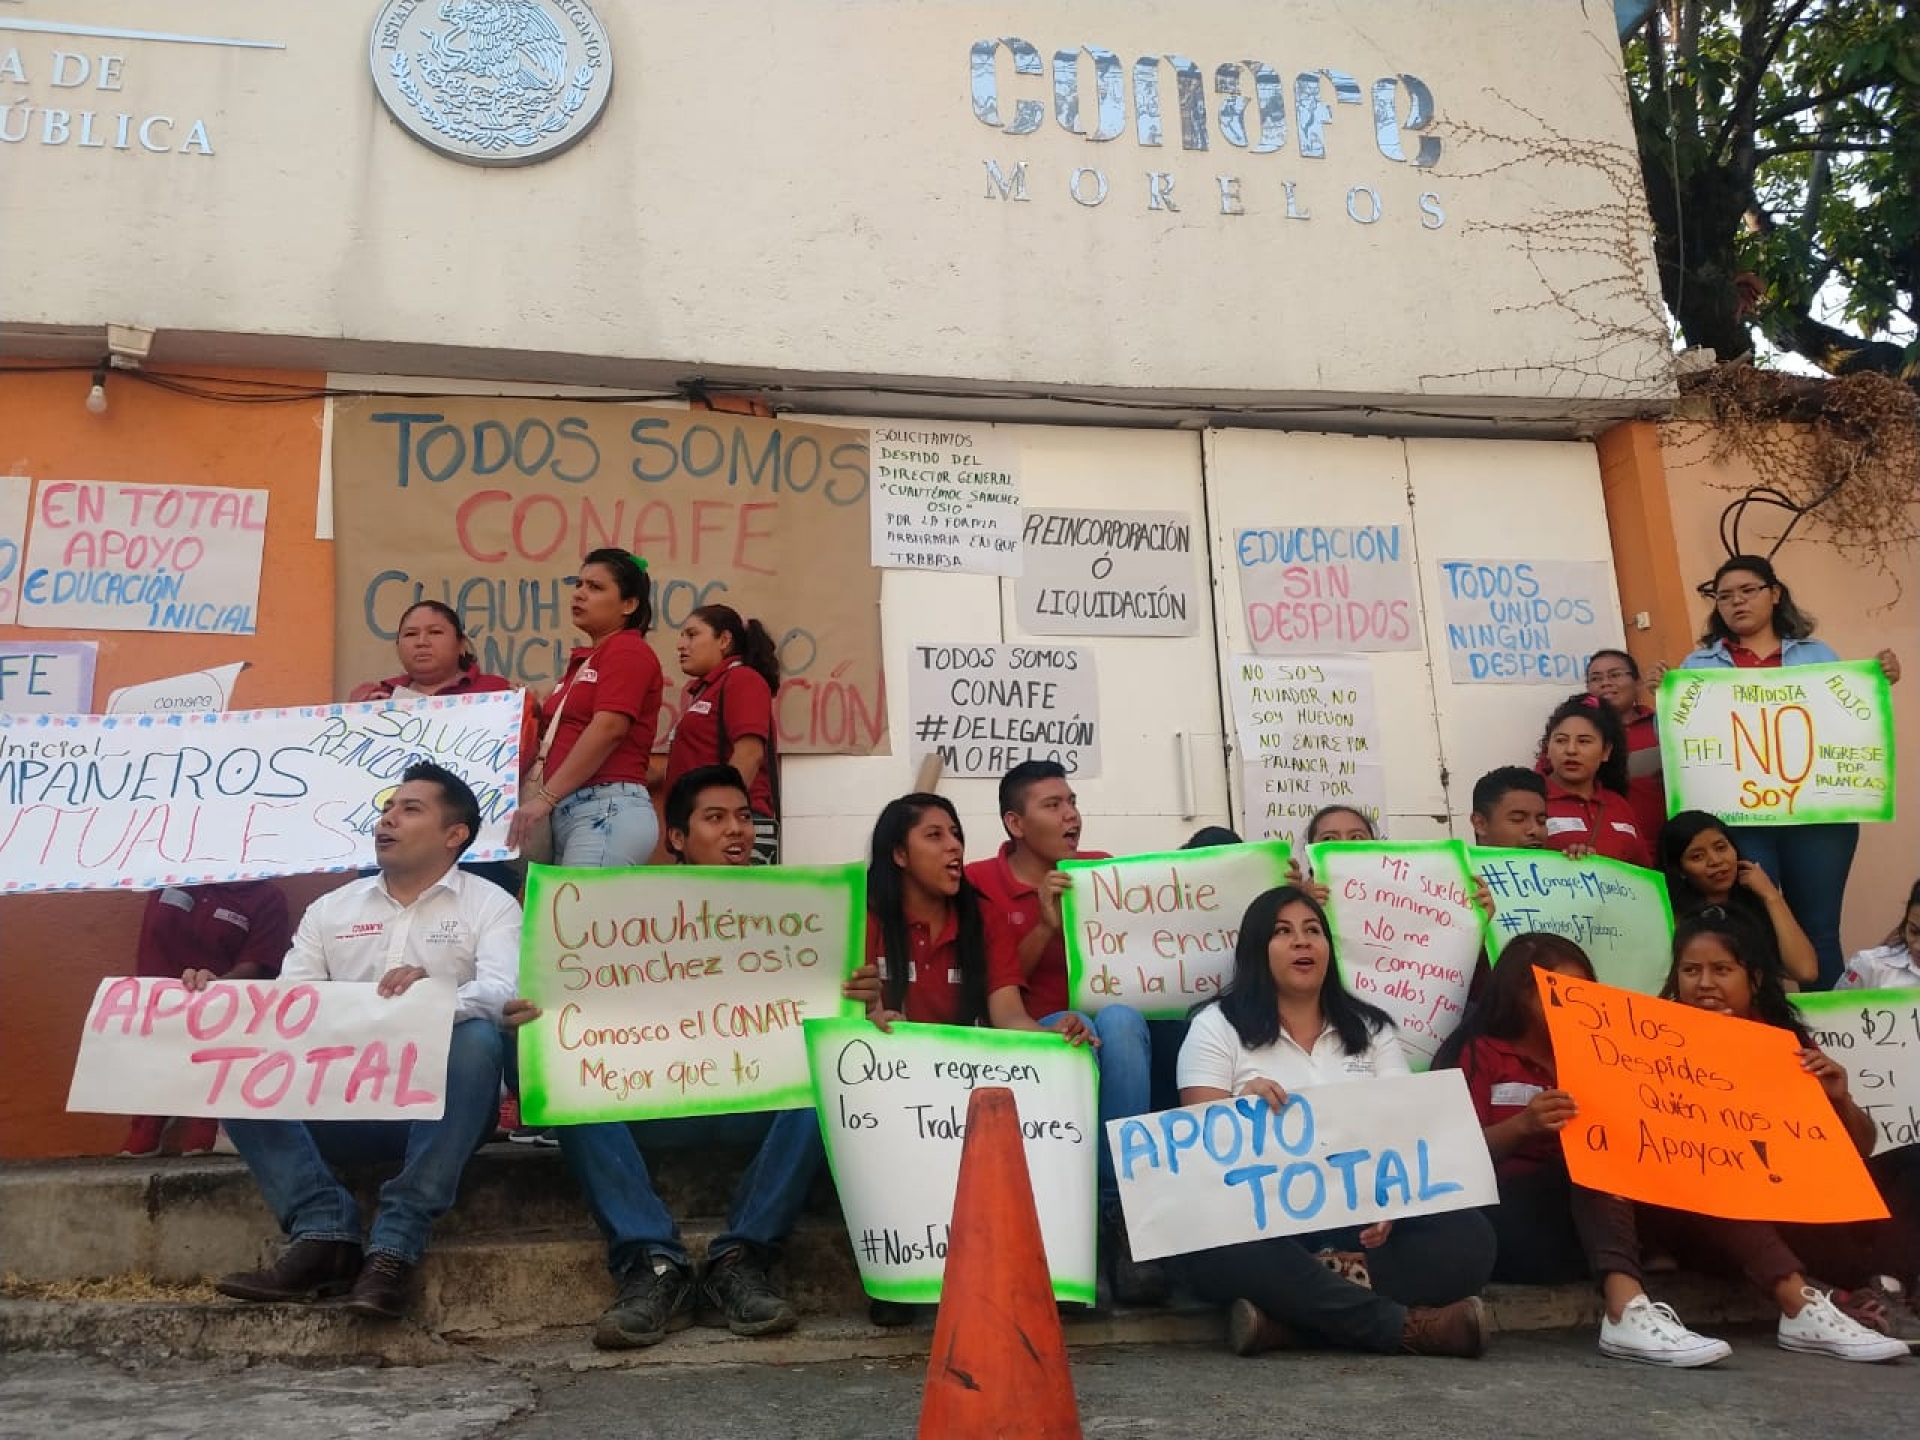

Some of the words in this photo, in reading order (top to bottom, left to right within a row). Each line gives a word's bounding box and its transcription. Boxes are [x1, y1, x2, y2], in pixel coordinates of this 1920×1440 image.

[51, 50, 126, 91] DE
[984, 160, 1447, 230] MORELOS
[875, 428, 973, 448] SOLICITAMOS
[878, 446, 940, 464] DESPIDO
[950, 453, 983, 466] DEL
[370, 412, 600, 488] TODOS
[630, 417, 870, 507] SOMOS
[878, 465, 951, 484] DIRECTOR
[41, 482, 106, 528] EN
[120, 488, 266, 531] TOTAL
[885, 512, 912, 526] POR
[62, 529, 204, 571] APOYO
[455, 490, 780, 577] CONAFE
[968, 535, 990, 549] EN
[1022, 513, 1190, 553] REINCORPORACIÓN
[1238, 525, 1400, 567] EDUCACIÓN
[23, 567, 185, 605] EDUCACIÓN
[1281, 564, 1350, 600] SIN
[1443, 562, 1540, 600] TODOS
[149, 602, 255, 633] INICIAL
[1035, 585, 1186, 621] LIQUIDACIÓN
[1489, 600, 1595, 626] UNIDOS
[1248, 600, 1411, 643] DESPIDOS
[1447, 622, 1551, 651] NINGÚN
[916, 646, 997, 671] TODOS
[1008, 647, 1079, 671] SOMOS
[1241, 664, 1264, 681] NO
[1278, 664, 1325, 683] SOY
[950, 679, 1059, 709] CONAFE
[1331, 689, 1357, 704] NO
[915, 714, 1095, 746] #DELEGACIÓN
[1250, 709, 1283, 727] SOY
[1259, 733, 1281, 748] NO
[1730, 704, 1816, 785] NO
[1818, 744, 1885, 762] INGRESE
[1836, 762, 1868, 774] POR
[1320, 780, 1354, 798] POR
[1382, 855, 1410, 881] Mi
[1091, 866, 1219, 915] Nadie
[1344, 878, 1367, 900] es
[552, 881, 822, 951] Cuauhtémoc
[1364, 915, 1395, 942] NO
[1403, 931, 1430, 948] me
[1084, 920, 1128, 957] Por
[558, 951, 723, 991] Sanchez
[1090, 964, 1122, 996] de
[1137, 966, 1165, 994] la
[1178, 959, 1222, 996] Ley
[1355, 971, 1378, 992] los
[92, 977, 320, 1041] APOYO
[558, 1002, 670, 1050] Conosco
[679, 1010, 706, 1040] el
[1627, 998, 1686, 1048] los
[191, 1040, 437, 1108] TOTAL
[580, 1057, 654, 1101] Mejor
[667, 1058, 720, 1096] que
[837, 1039, 911, 1085] Que
[935, 1060, 1040, 1090] regresen
[1590, 1034, 1735, 1091] Despides
[839, 1094, 879, 1130] los
[1720, 1108, 1772, 1132] nos
[1119, 1092, 1315, 1181] APOYO
[1586, 1124, 1609, 1152] a
[1223, 1139, 1464, 1231] TOTAL
